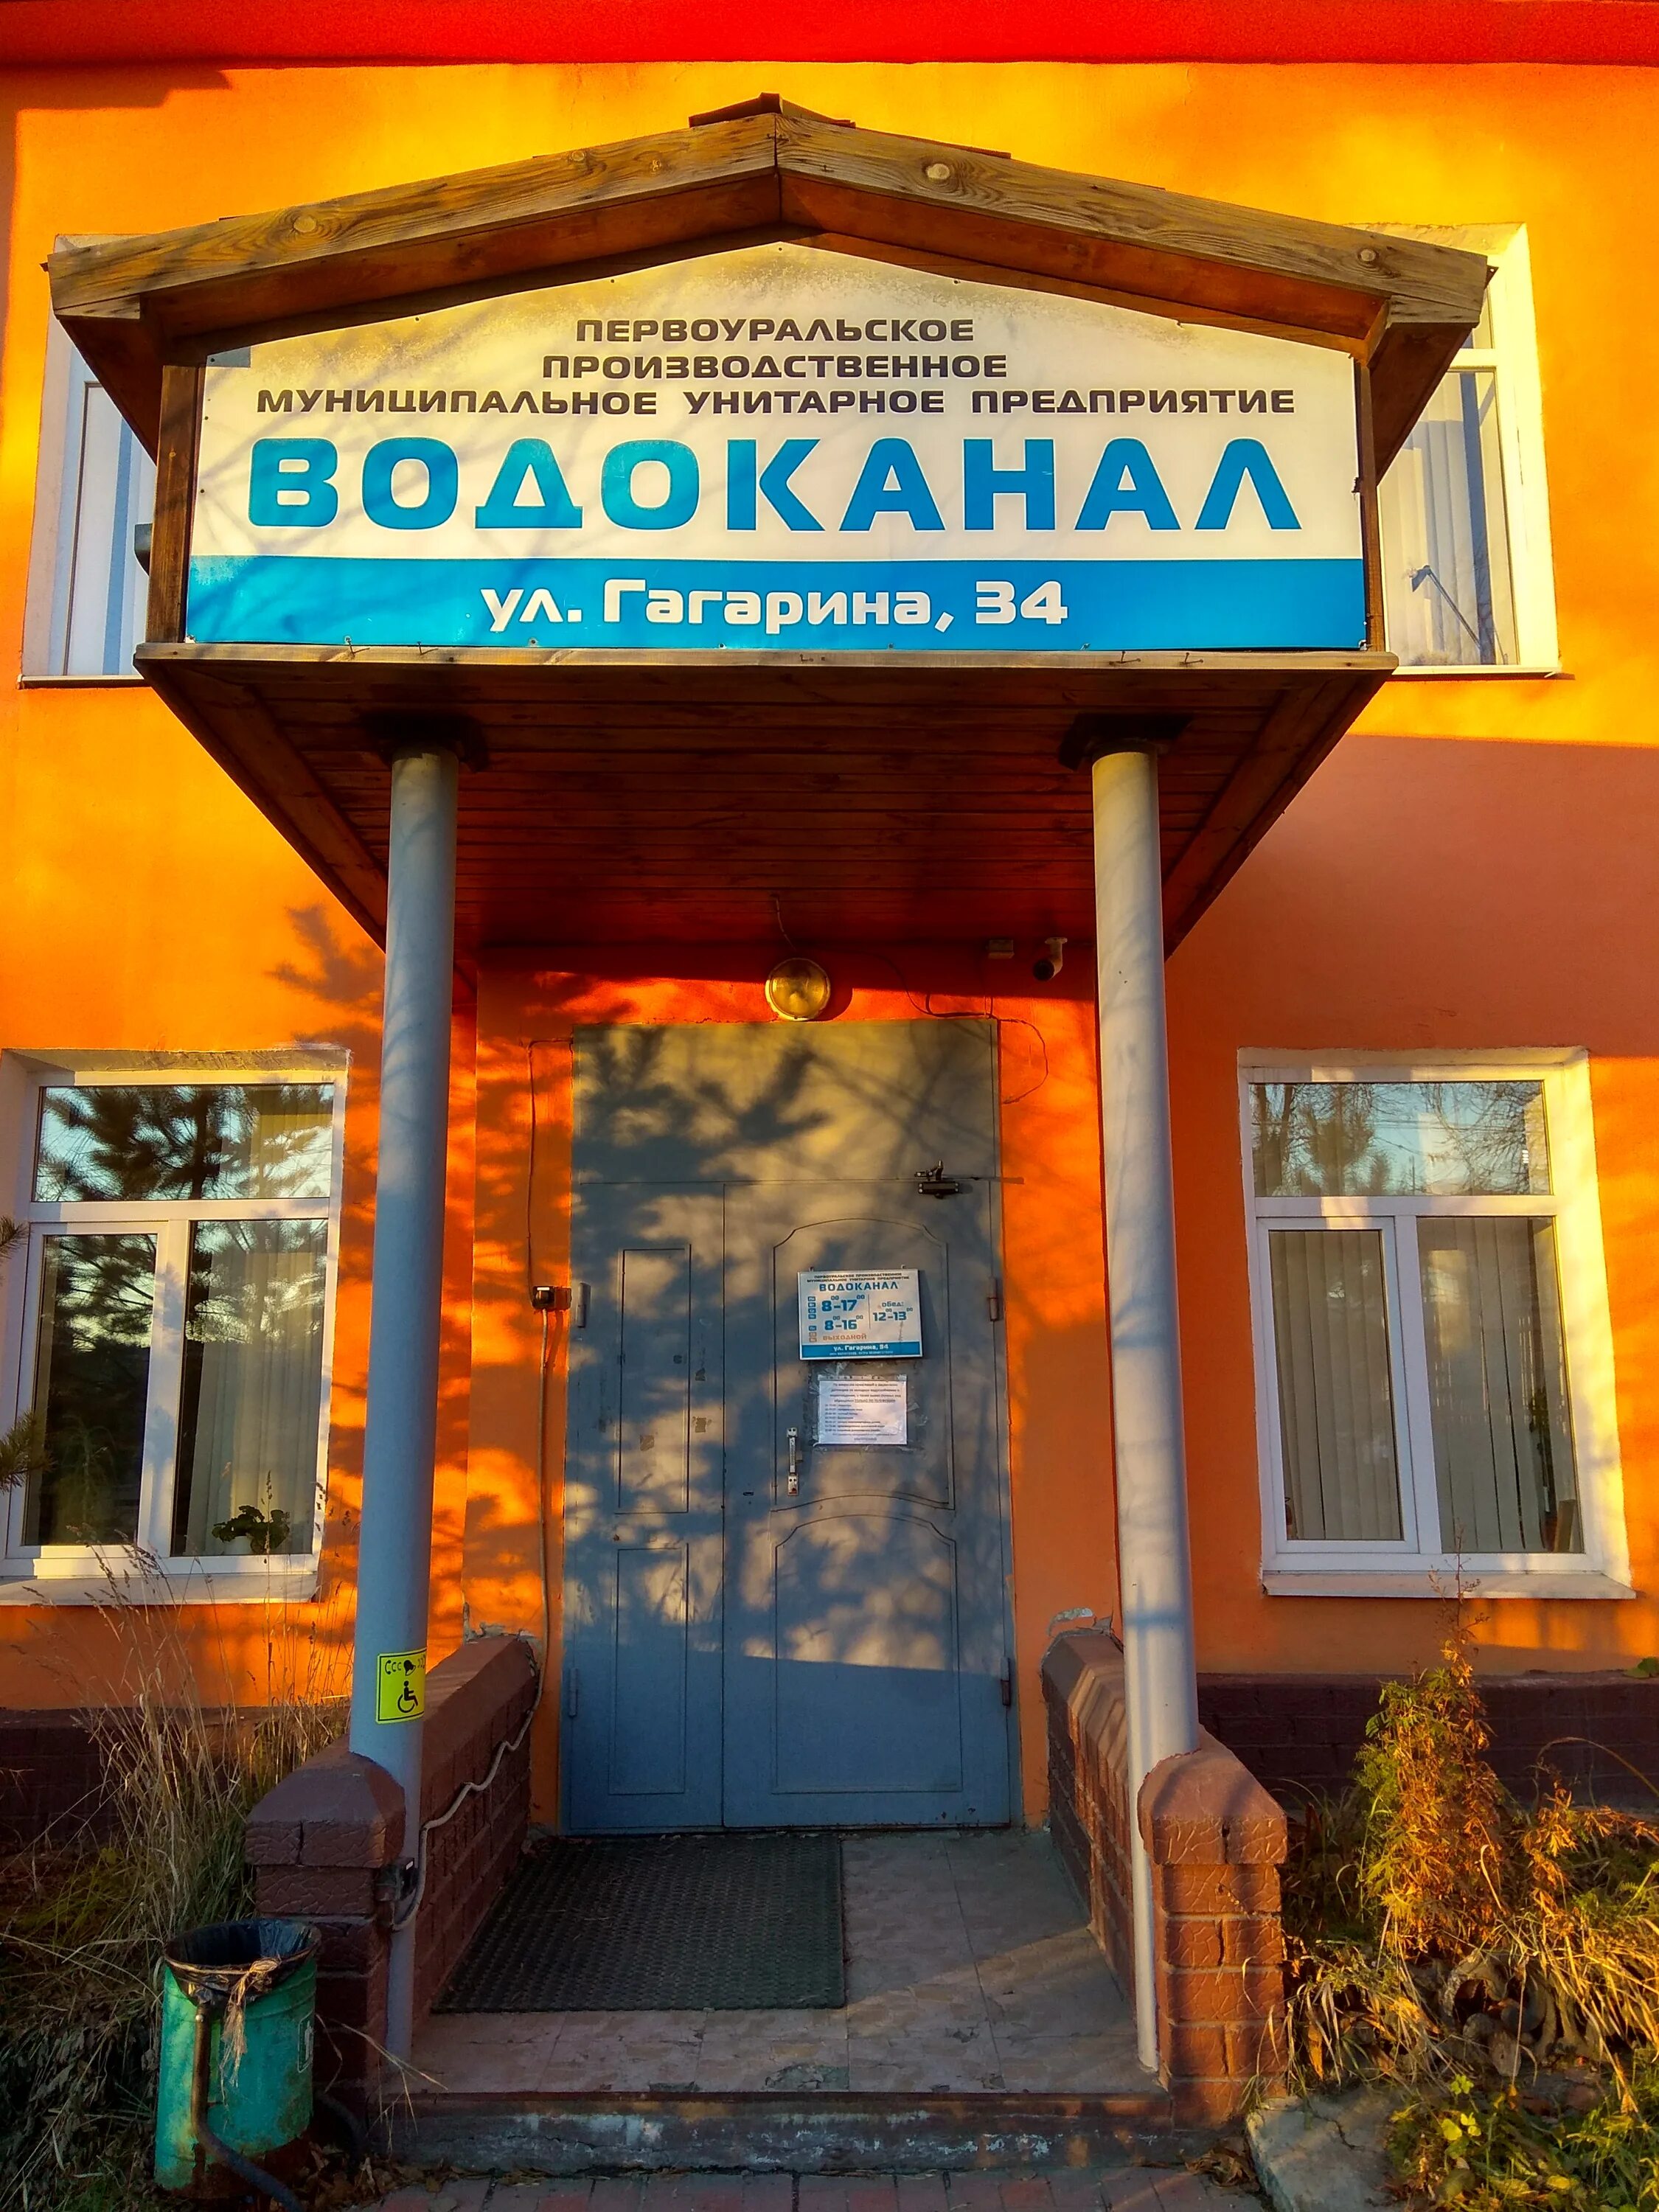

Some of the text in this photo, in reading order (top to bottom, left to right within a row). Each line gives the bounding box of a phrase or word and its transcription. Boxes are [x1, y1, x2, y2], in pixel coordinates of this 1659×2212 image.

[576, 319, 974, 343] ПЕРВОУРАЛЬСКОЕ
[543, 354, 1007, 379] ПРОИЗВОДСТВЕННОЕ
[257, 389, 1295, 415] МУНИЦИПАЛЬНОЕ УНИТАРНОЕ ПРЕДПРИЯТИЕ
[248, 437, 1303, 532] ВОДОКАНАЛ
[480, 579, 1068, 635] ул. Гагарина, 34
[819, 1281, 898, 1292] ВОДОКАНАЛ
